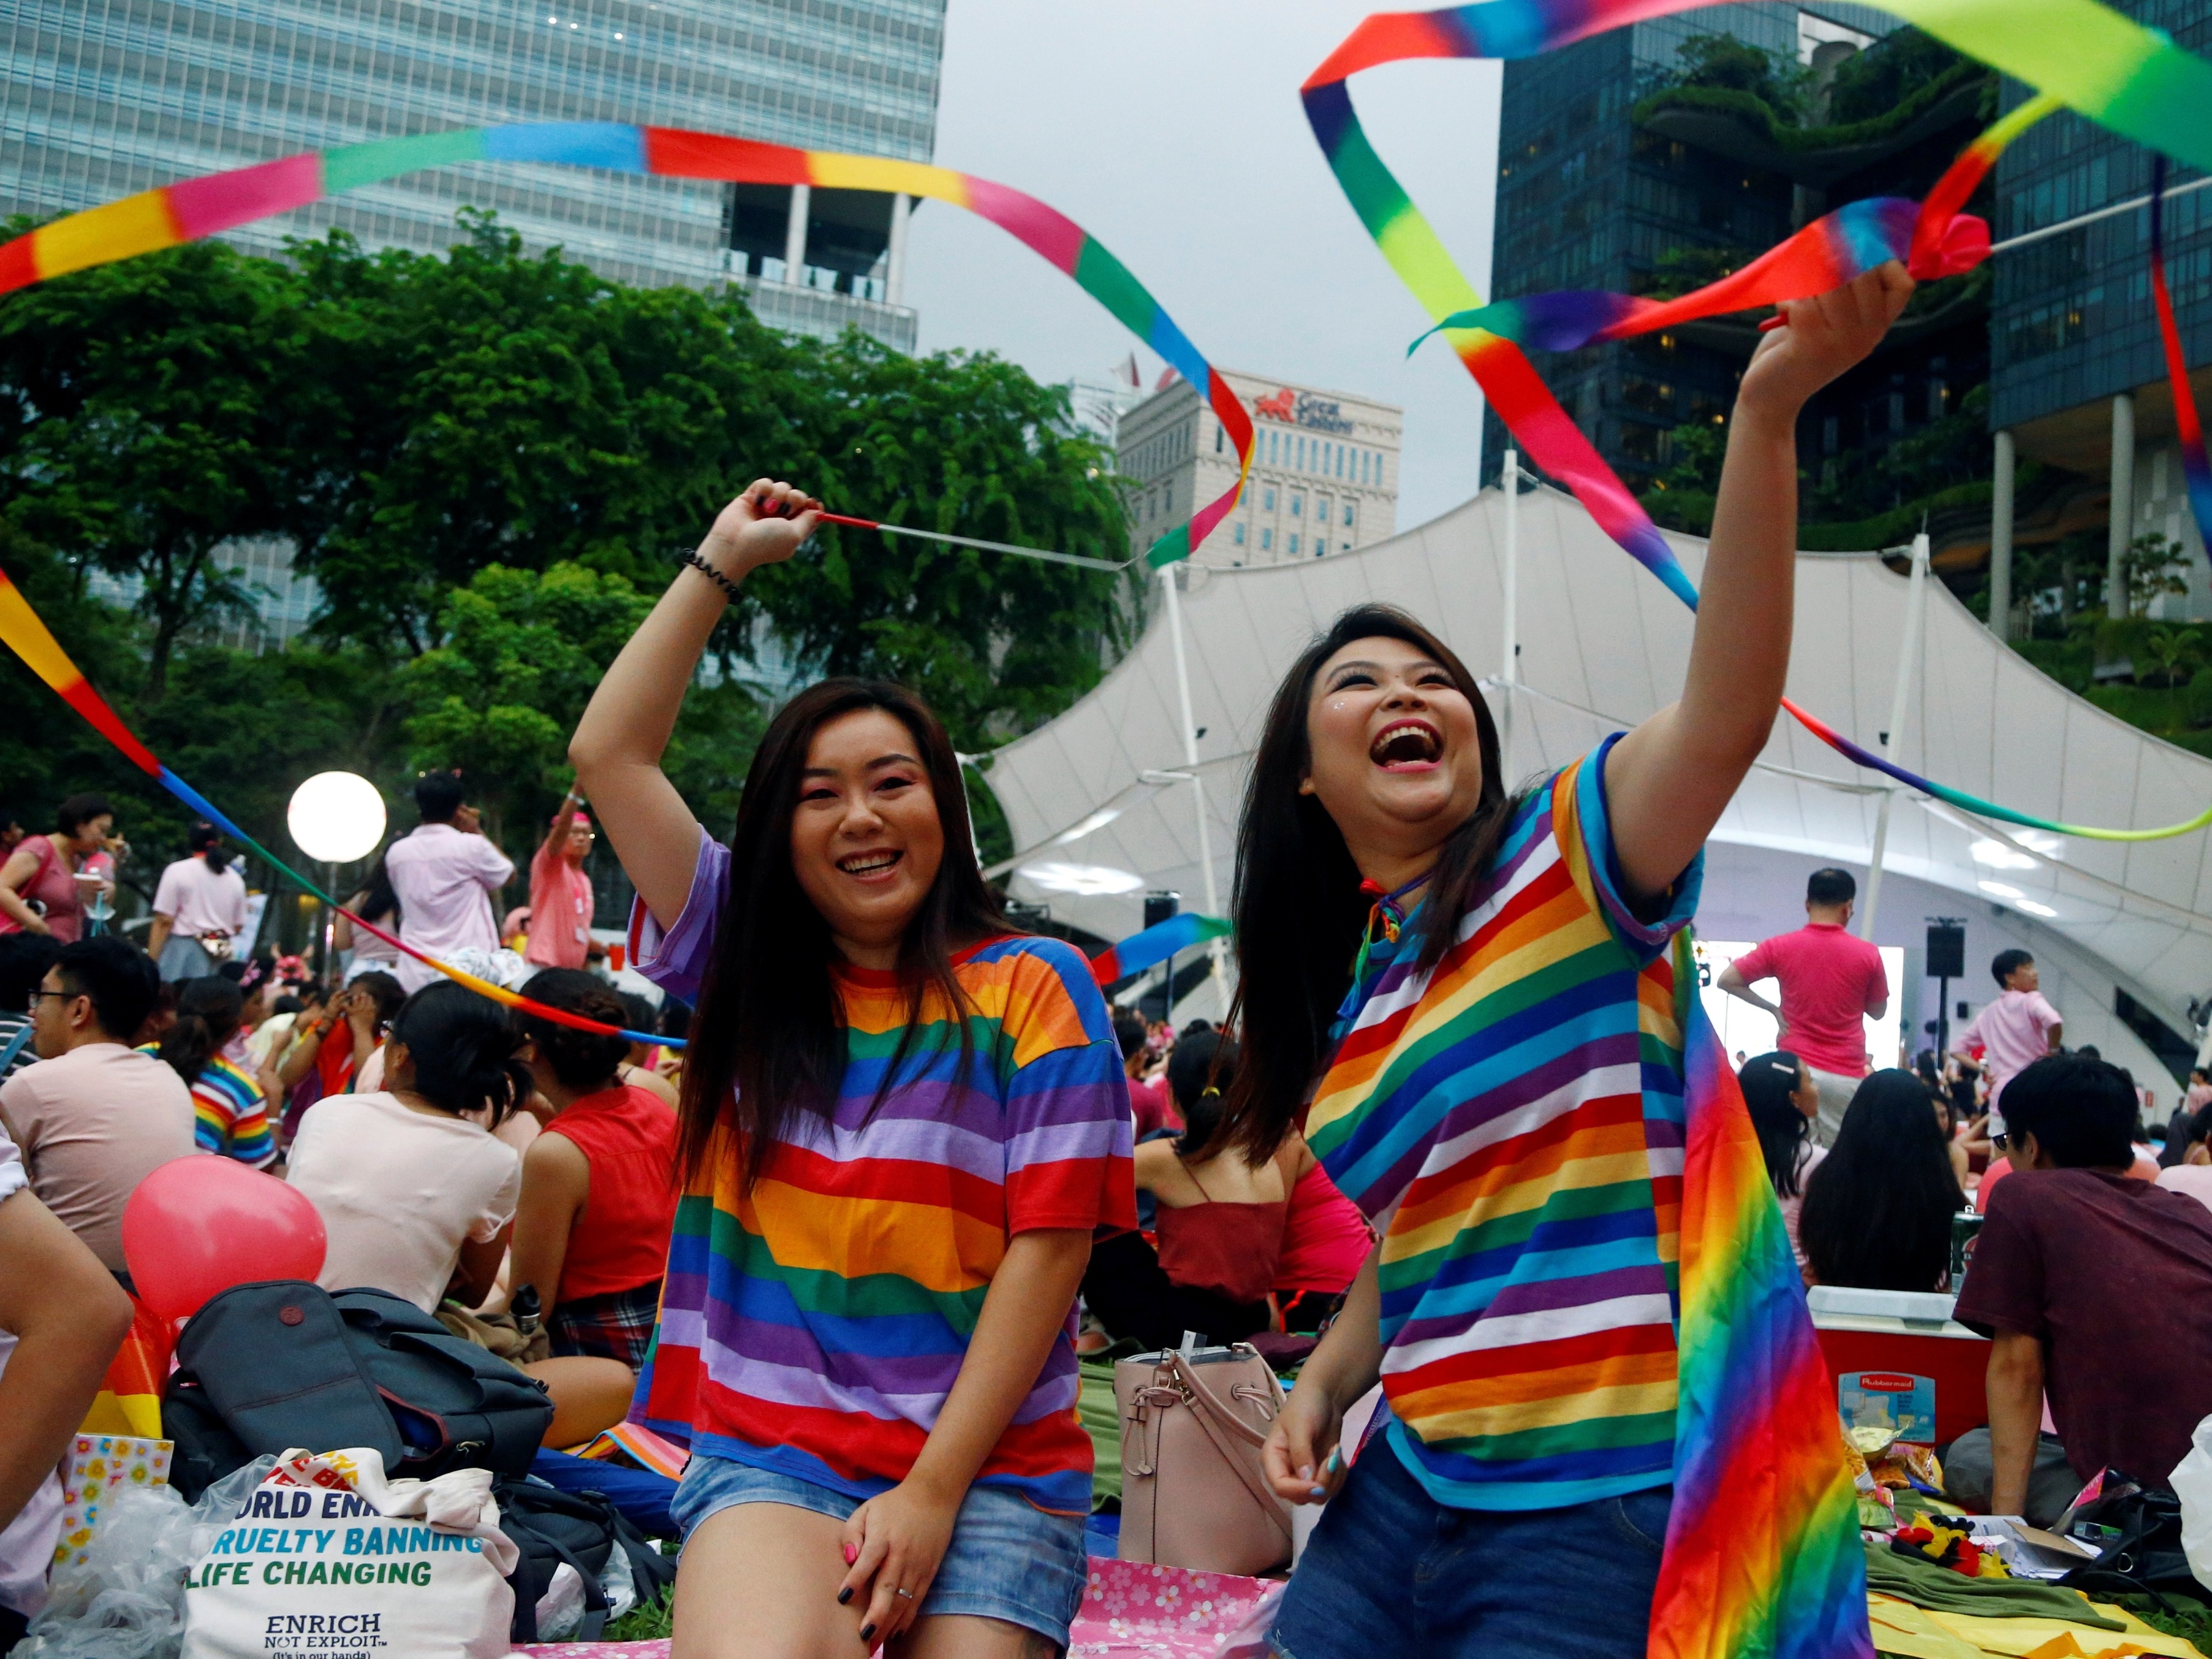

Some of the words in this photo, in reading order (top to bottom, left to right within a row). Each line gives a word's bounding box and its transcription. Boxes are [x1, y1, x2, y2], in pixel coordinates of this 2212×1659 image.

[1862, 1378, 1911, 1387] Rubbermaid
[343, 1527, 483, 1555] BANNING
[186, 1562, 253, 1589] LIFE
[263, 1562, 431, 1587] CHANGING
[266, 1613, 380, 1633] ENRICH
[265, 1636, 301, 1648] NOT
[332, 1650, 370, 1659] hands)
